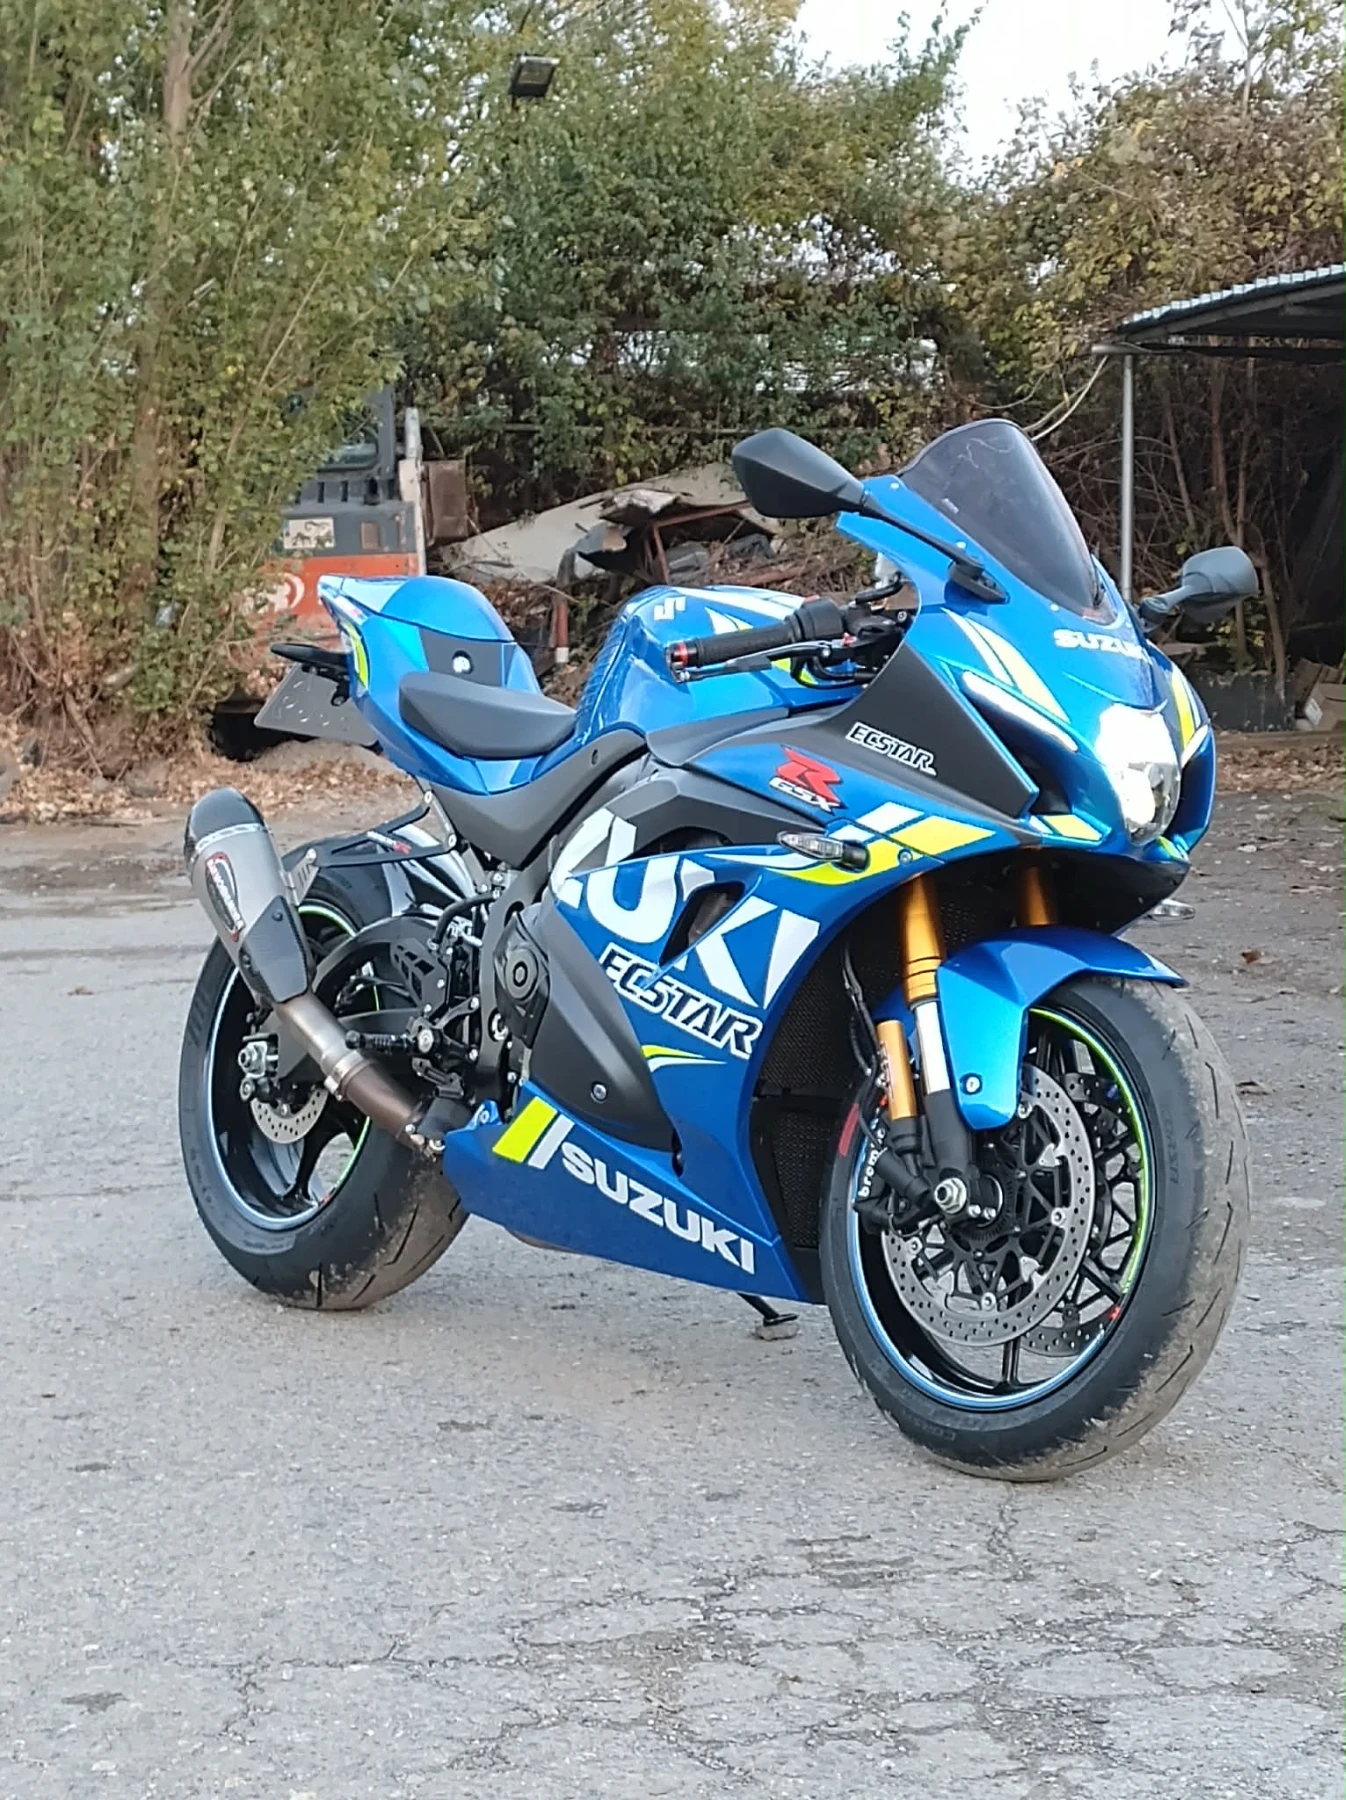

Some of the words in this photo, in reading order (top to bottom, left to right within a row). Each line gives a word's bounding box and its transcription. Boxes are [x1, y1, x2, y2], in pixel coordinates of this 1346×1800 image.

[845, 721, 937, 776] ECSTAR
[768, 776, 841, 813] GSX
[599, 942, 763, 1059] ECSTAR
[561, 1141, 755, 1274] SUZUKI
